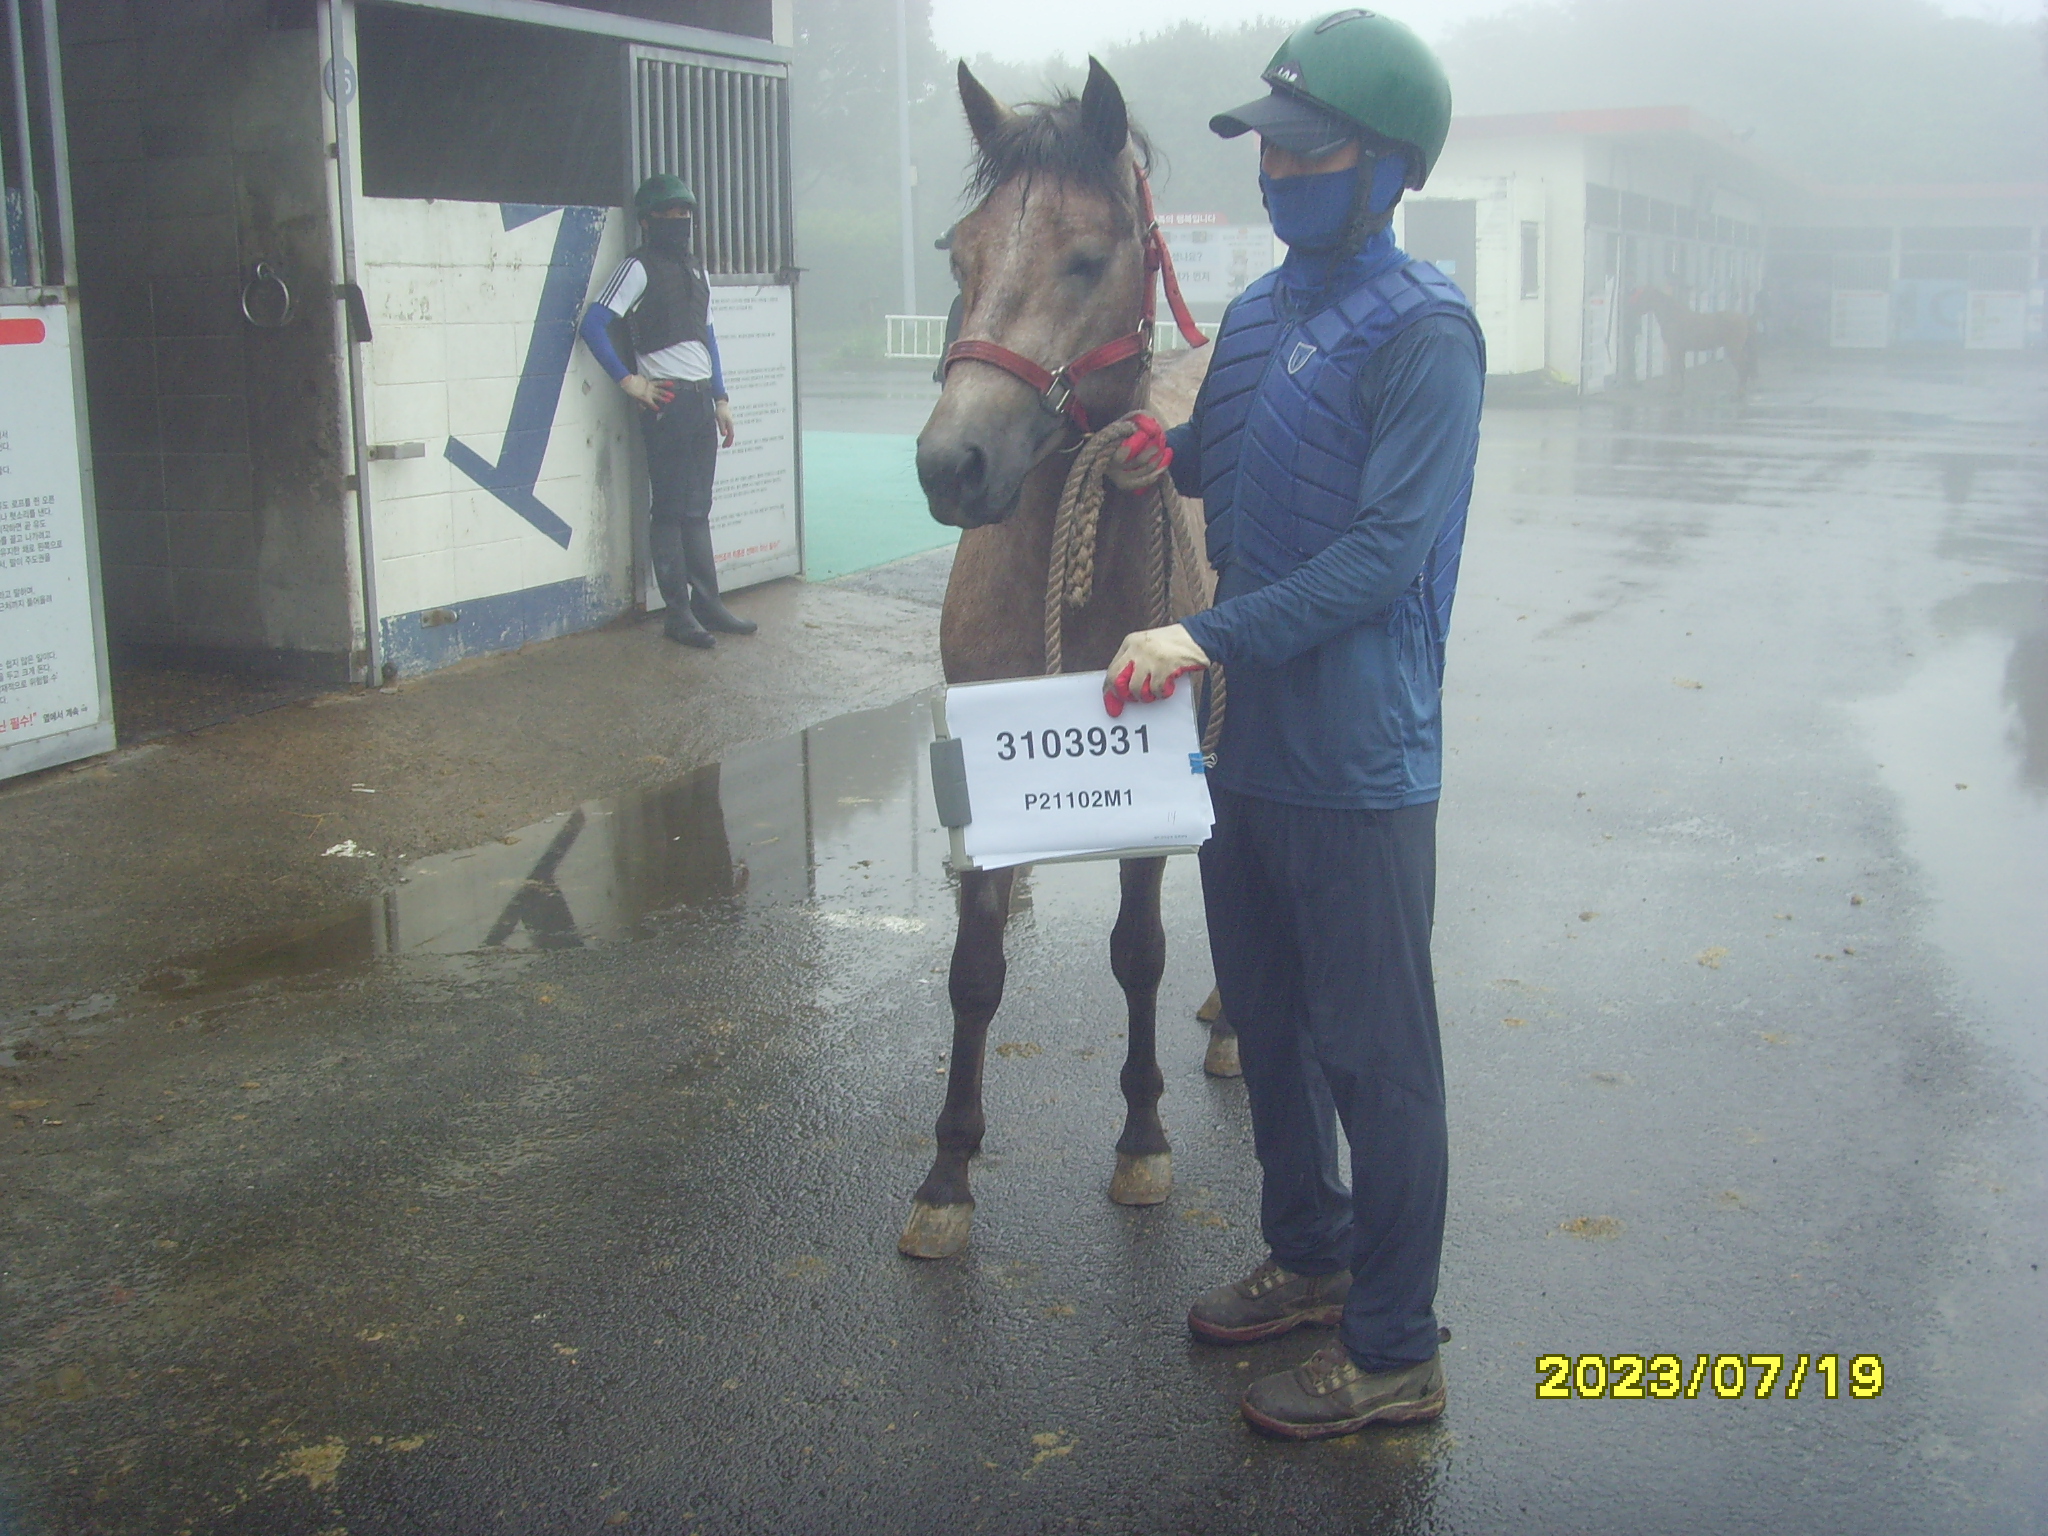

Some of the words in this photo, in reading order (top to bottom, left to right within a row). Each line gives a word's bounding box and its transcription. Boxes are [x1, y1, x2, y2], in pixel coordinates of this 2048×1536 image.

[33, 519, 47, 529] 유도
[21, 666, 36, 677] 크게
[996, 724, 1150, 761] 3103931
[1024, 788, 1133, 811] P21102M1
